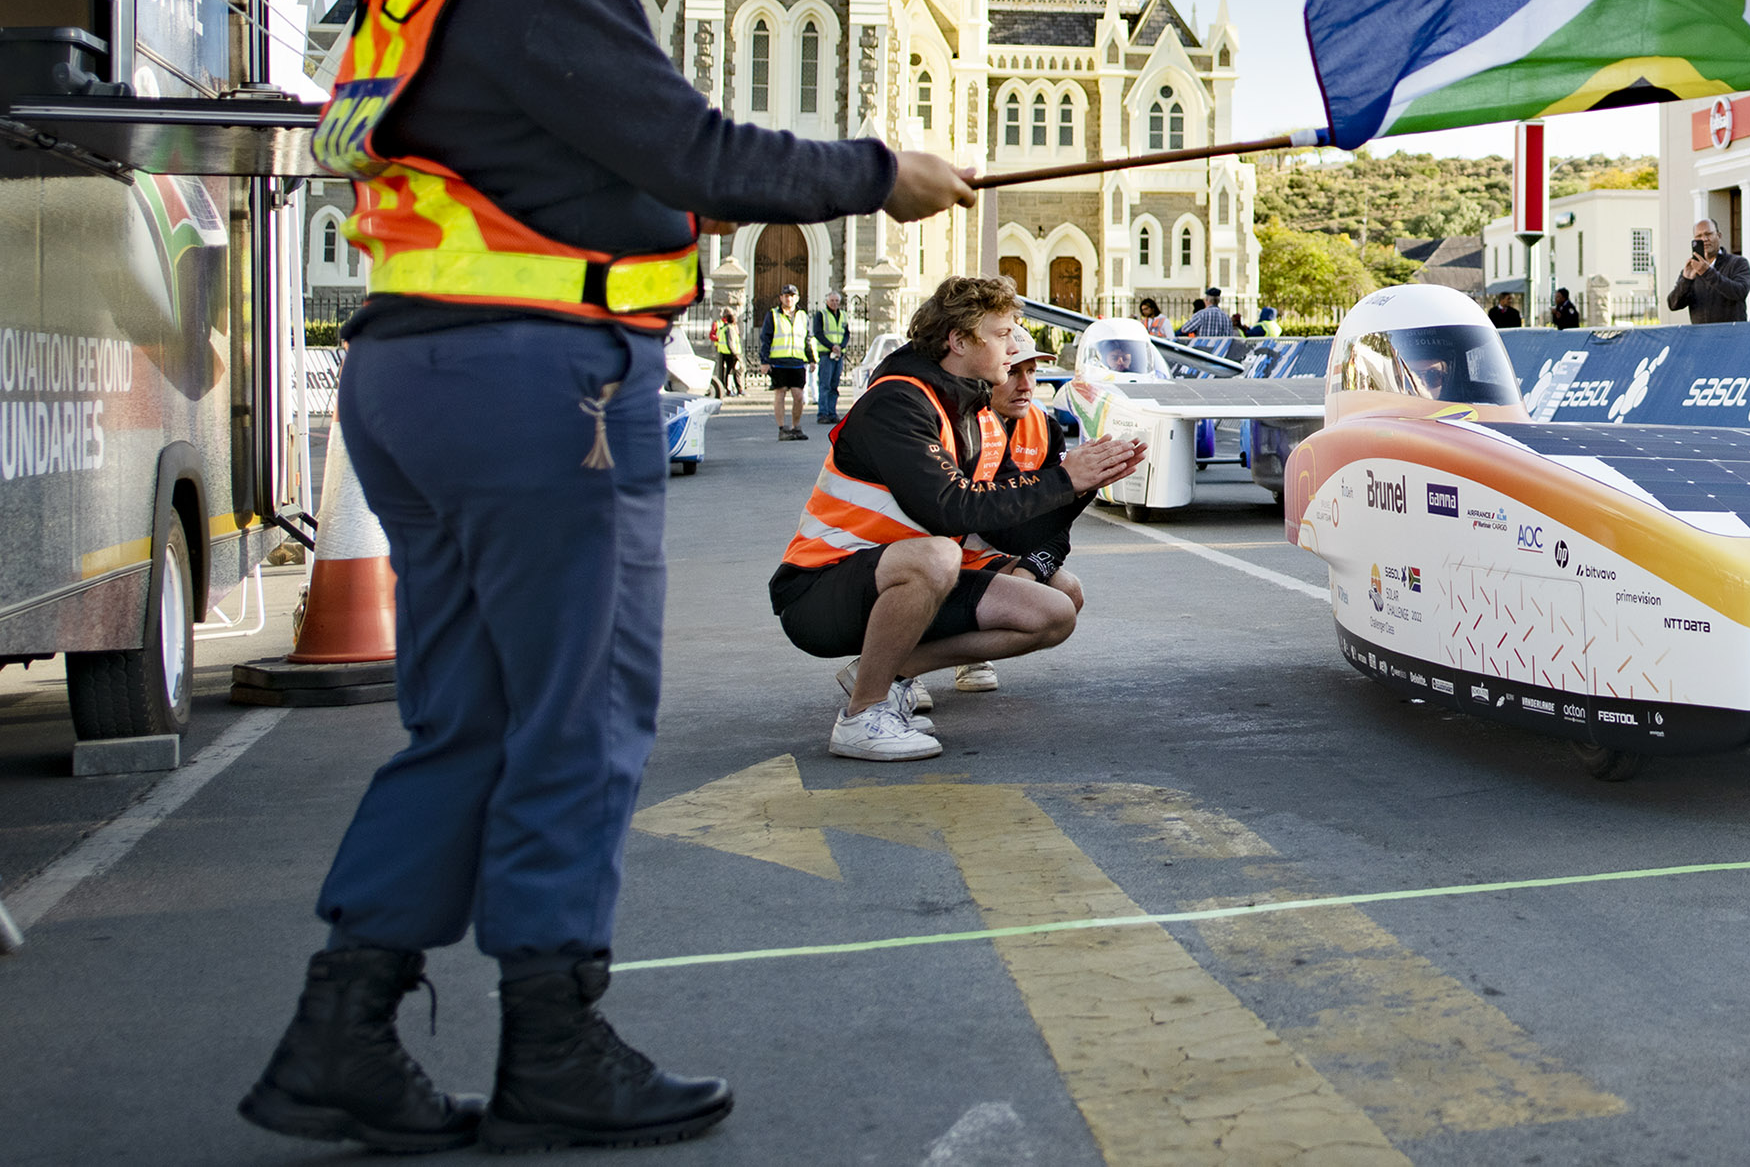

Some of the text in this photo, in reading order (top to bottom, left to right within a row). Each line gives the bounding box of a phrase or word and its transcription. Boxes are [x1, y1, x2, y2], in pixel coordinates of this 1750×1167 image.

[0, 327, 73, 392] OVATION
[77, 336, 133, 392] BEYOND
[0, 399, 104, 480] UNDARIES
[1366, 469, 1407, 514] Brunel
[1517, 524, 1543, 548] AOC
[1585, 565, 1616, 580] bitvavo
[1616, 589, 1662, 606] primevision
[1598, 710, 1639, 725] FESTOOL
